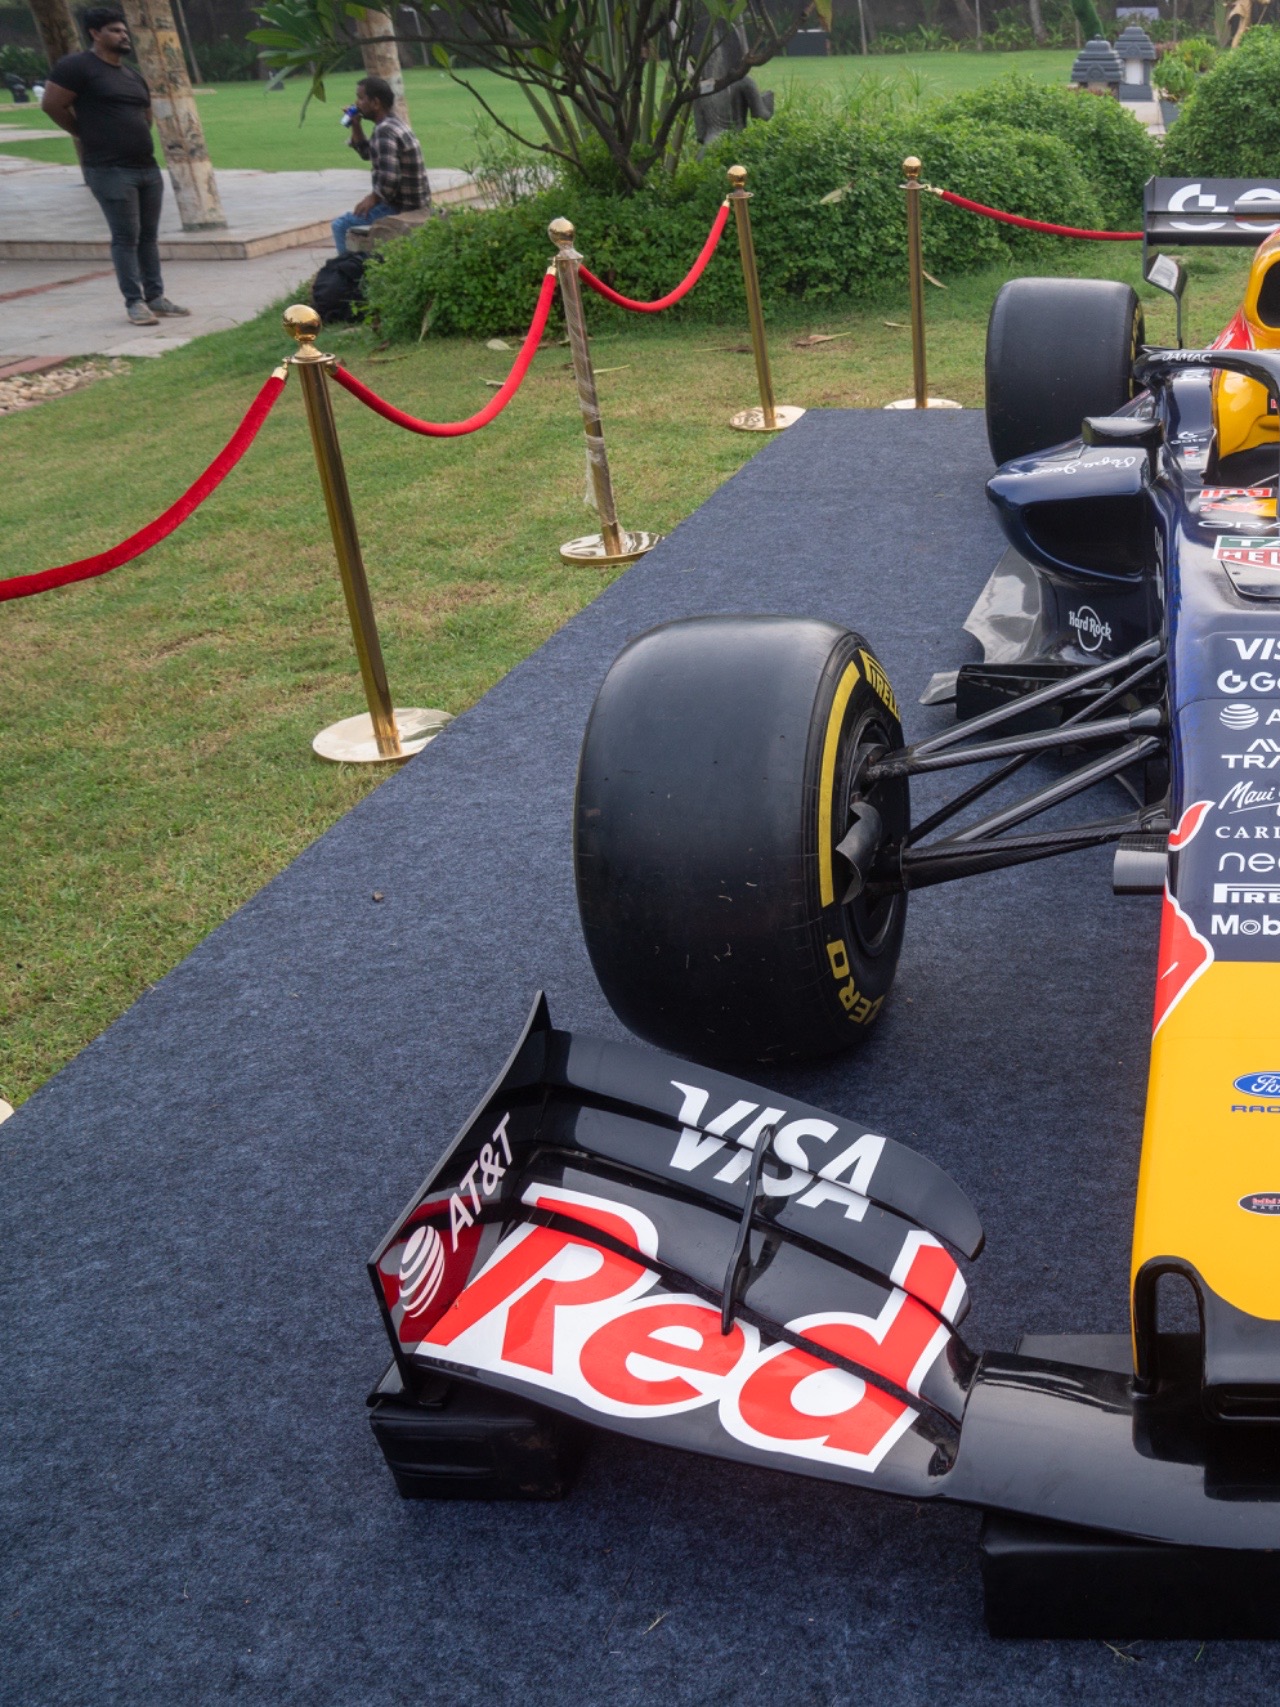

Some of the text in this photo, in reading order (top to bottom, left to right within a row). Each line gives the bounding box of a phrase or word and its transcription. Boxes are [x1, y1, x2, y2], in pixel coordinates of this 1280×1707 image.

[1068, 610, 1112, 641] Hard Rock
[1217, 780, 1275, 811] Maui
[449, 1112, 515, 1252] AT&T
[669, 1079, 888, 1223] VISA
[414, 1182, 968, 1473] Red
